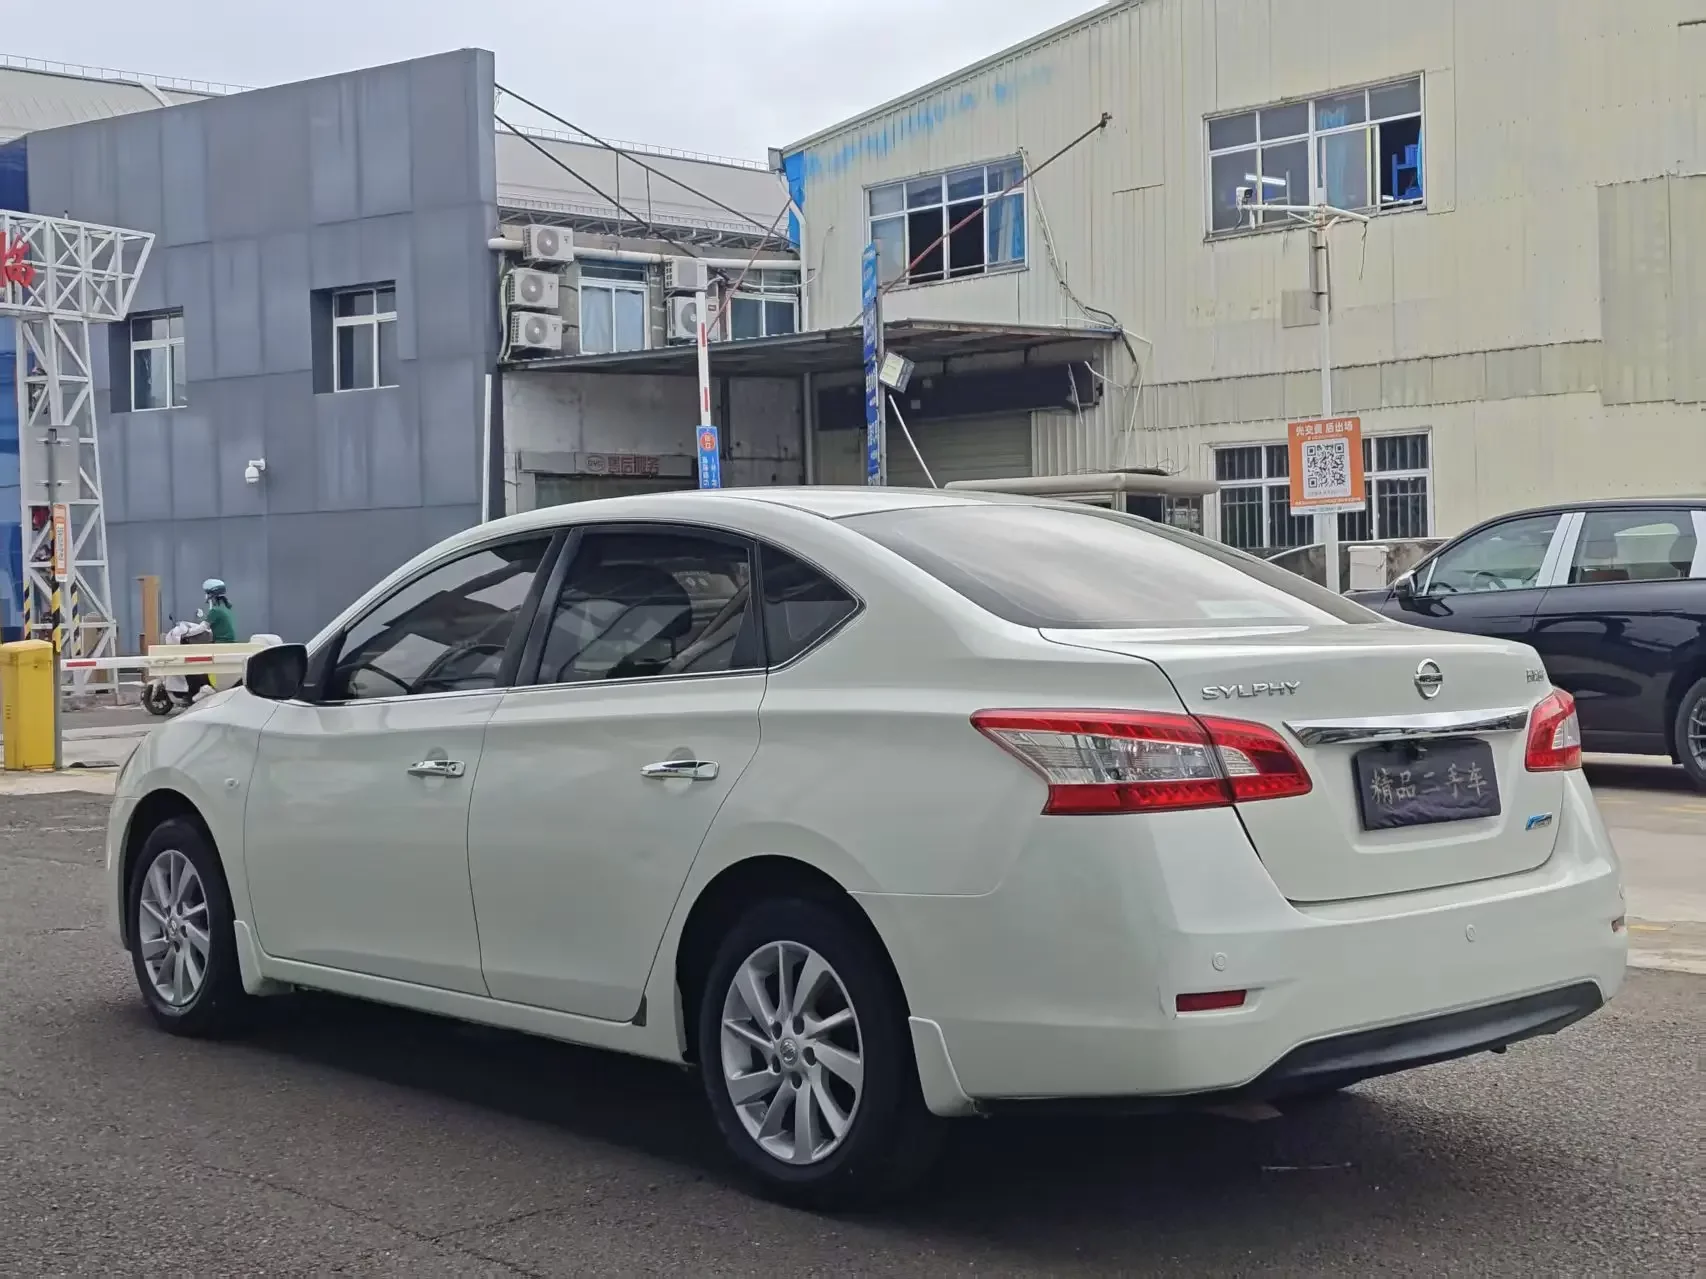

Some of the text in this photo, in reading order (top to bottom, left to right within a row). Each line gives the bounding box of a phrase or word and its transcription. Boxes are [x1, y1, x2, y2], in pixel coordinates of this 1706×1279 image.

[1201, 680, 1301, 701] SYLPHY
[1369, 761, 1488, 805] 精品二手车
